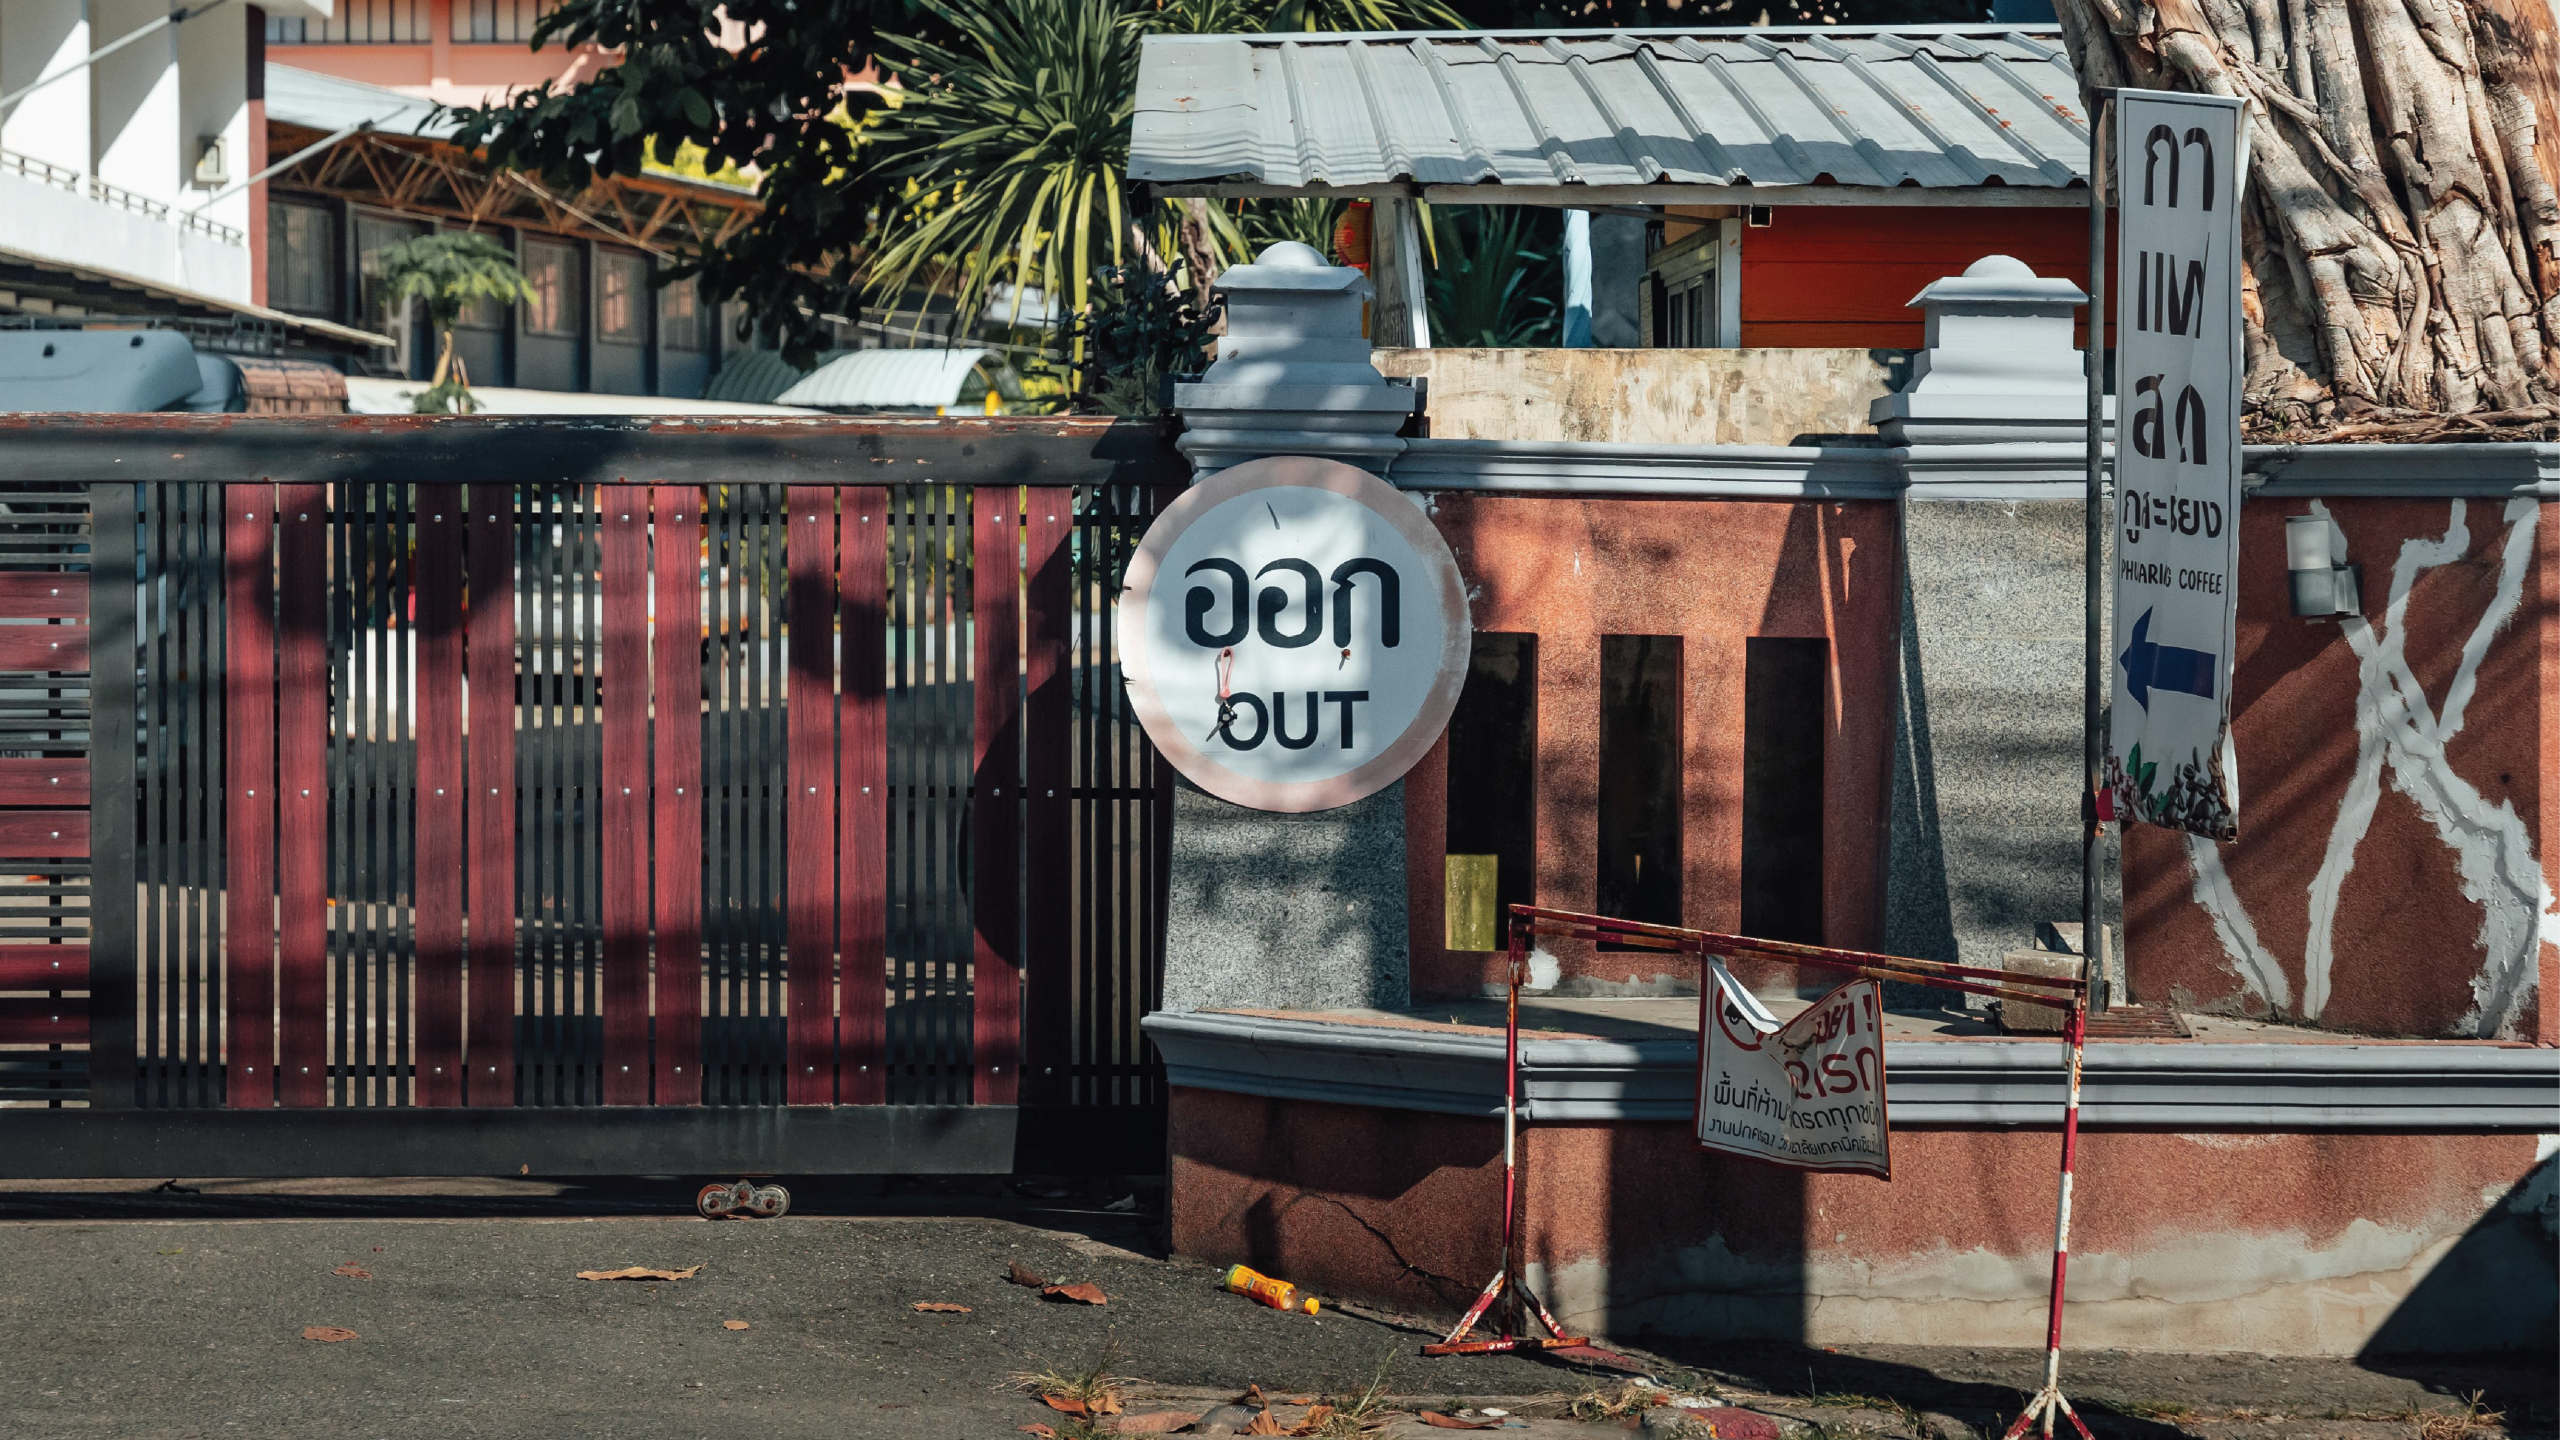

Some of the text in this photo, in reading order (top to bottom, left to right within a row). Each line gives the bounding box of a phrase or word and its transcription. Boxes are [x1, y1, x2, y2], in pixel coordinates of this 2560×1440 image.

[1184, 557, 1400, 649] ออก
[2179, 568, 2222, 595] COFFEE
[1218, 690, 1369, 751] OUT
